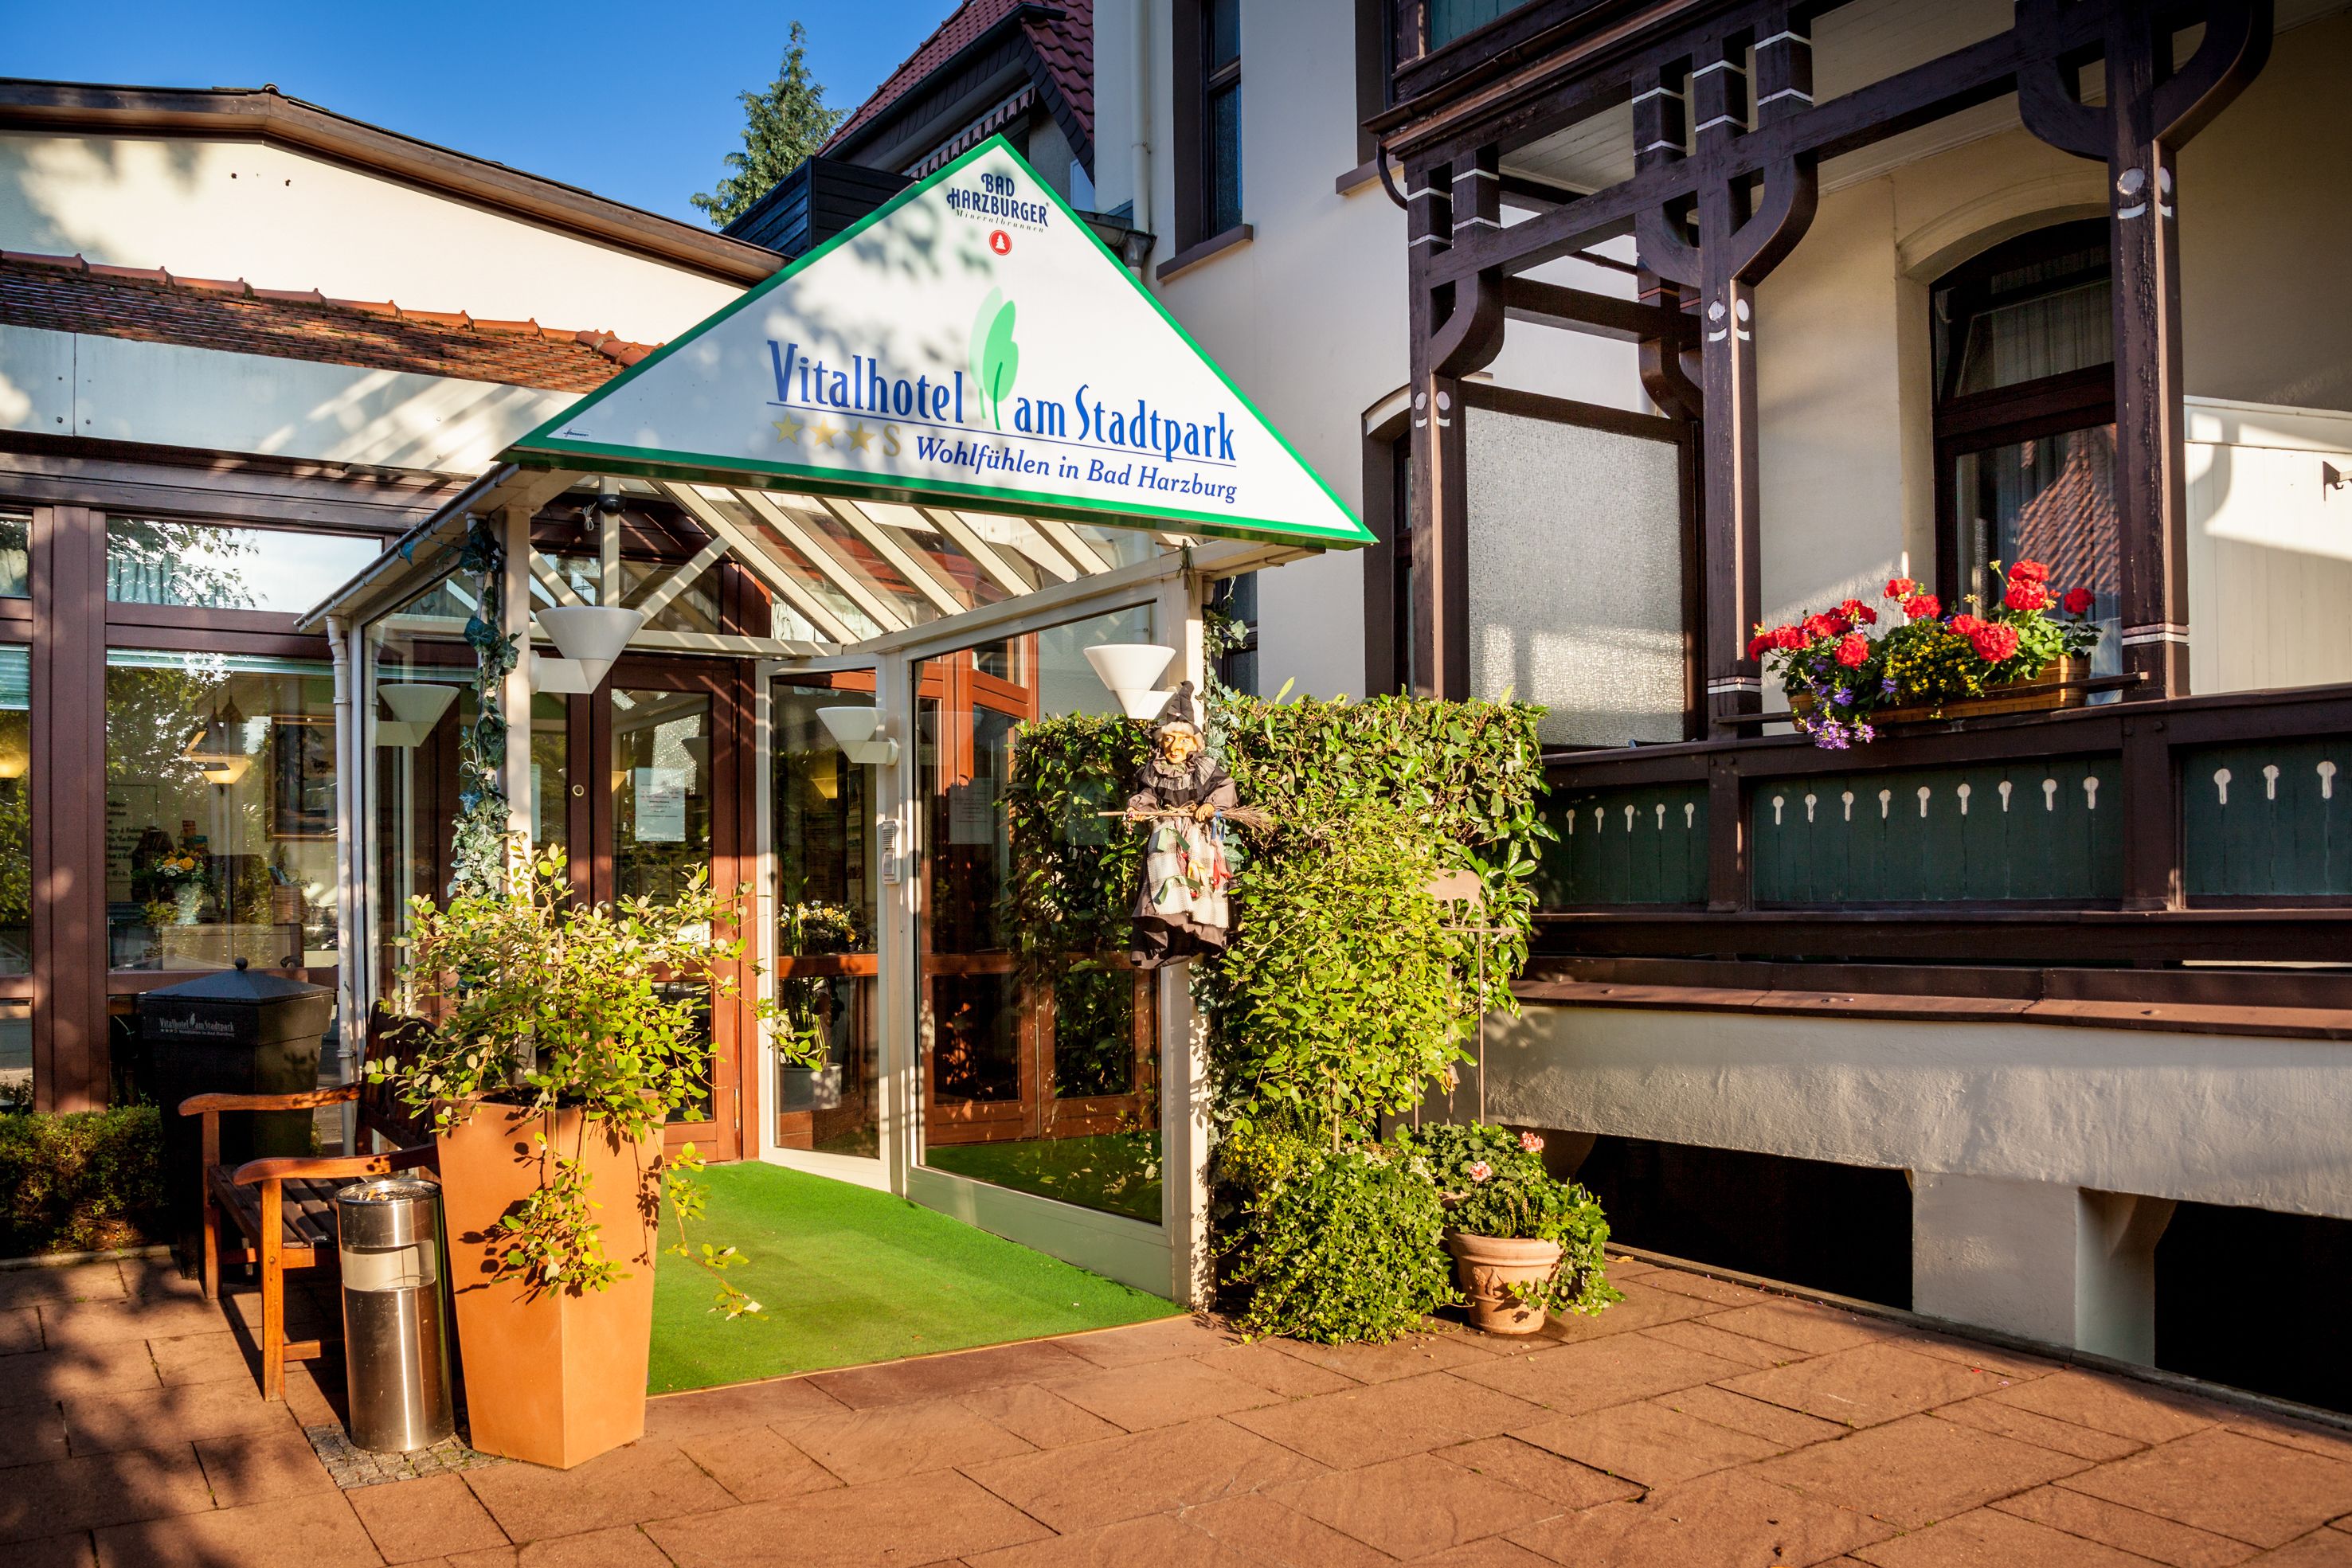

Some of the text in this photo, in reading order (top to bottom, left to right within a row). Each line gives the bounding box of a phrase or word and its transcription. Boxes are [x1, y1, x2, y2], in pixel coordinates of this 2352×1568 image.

[980, 173, 1015, 197] BAD
[946, 187, 1049, 227] HARZBURGER
[955, 209, 1044, 233] Mineralbrunnen
[766, 339, 1237, 463] Vitalhotel am Stadtpark
[916, 436, 1050, 477] Wohlfühlen
[1059, 456, 1079, 479] in
[1087, 459, 1130, 487] Bad
[1137, 467, 1238, 504] Harzburg
[159, 1017, 189, 1029] Vitalhotel
[205, 1020, 234, 1032] Stadtpark
